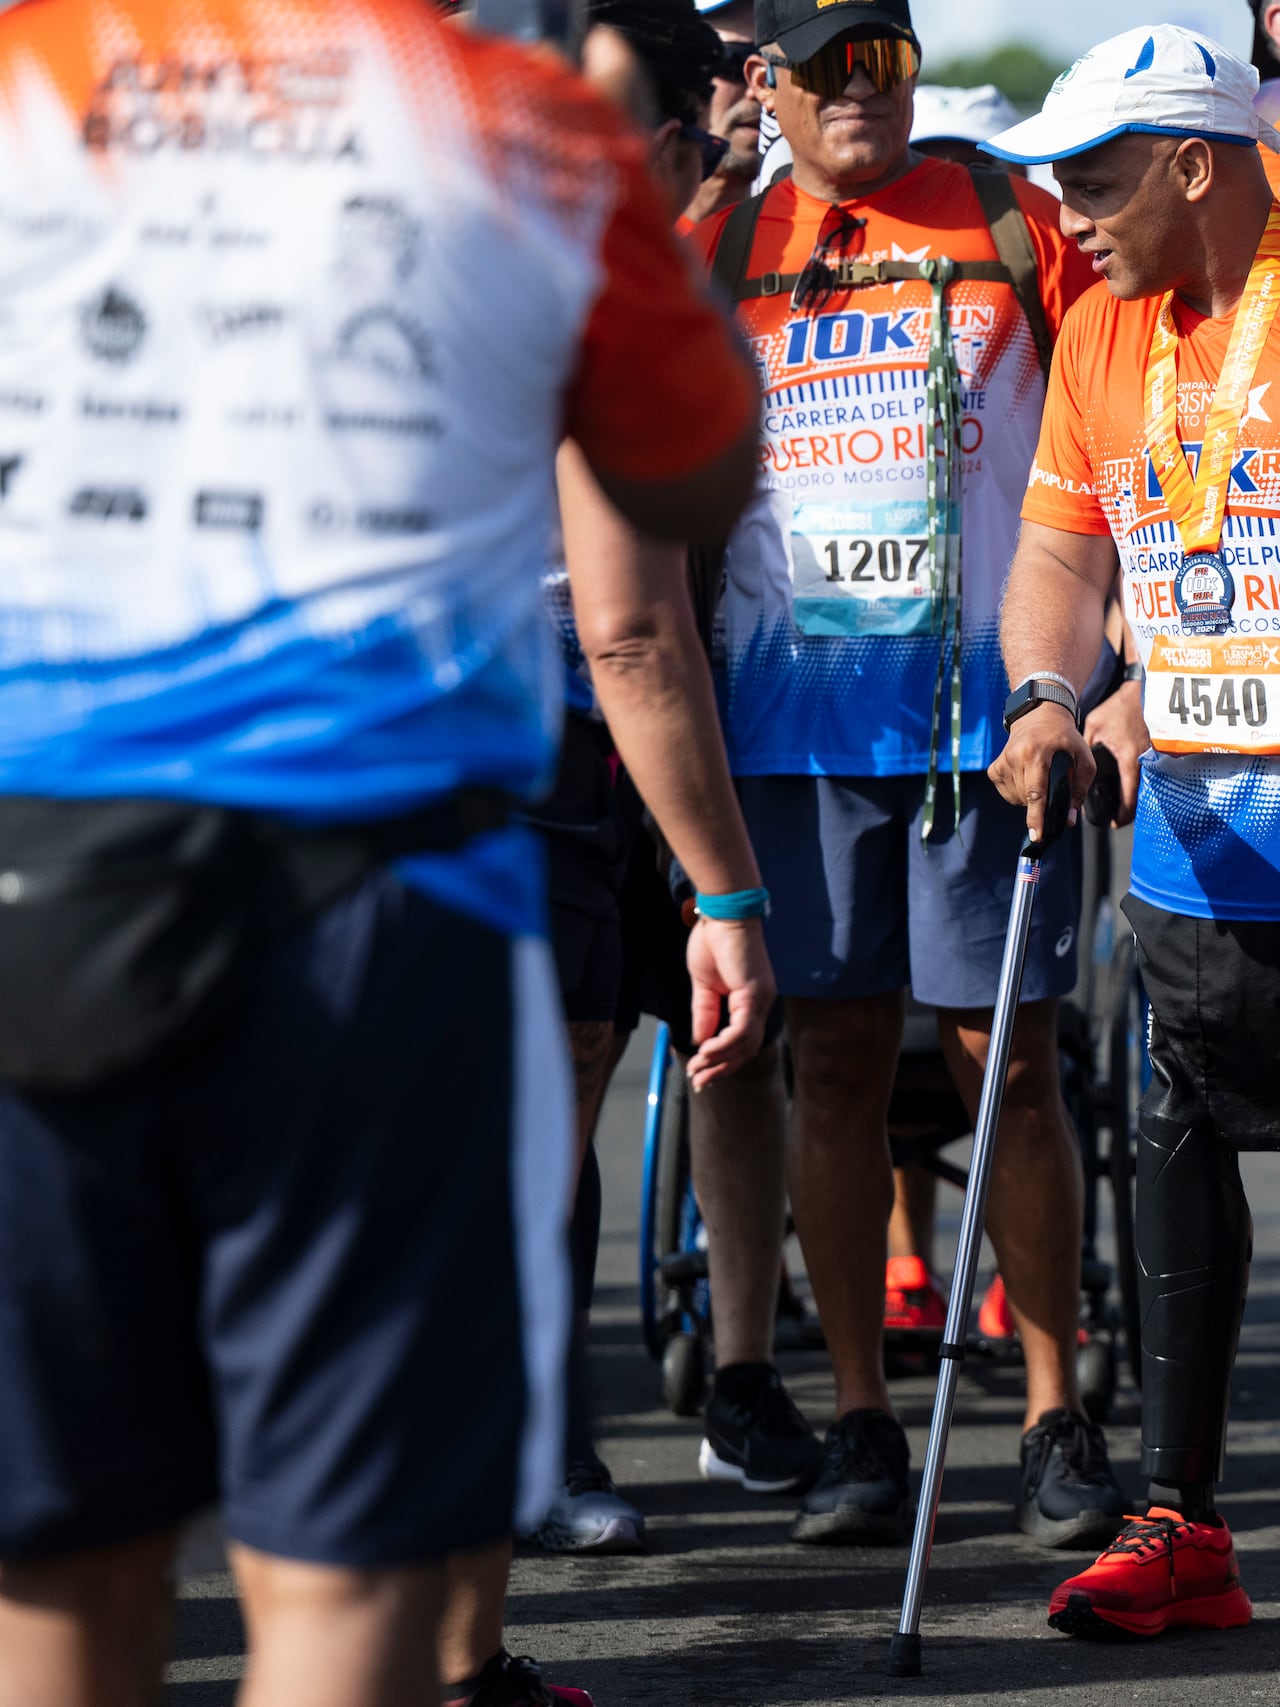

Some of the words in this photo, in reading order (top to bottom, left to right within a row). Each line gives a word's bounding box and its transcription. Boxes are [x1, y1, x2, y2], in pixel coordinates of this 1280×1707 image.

[1259, 271, 1276, 299] RUN
[785, 309, 919, 366] 10K
[765, 402, 865, 433] CARRERA
[870, 398, 910, 420] DEL
[914, 391, 986, 416] PNTE
[1104, 459, 1133, 488] PR
[824, 539, 929, 582] 1207
[1222, 546, 1259, 566] DEL
[1194, 567, 1208, 577] PR
[1186, 576, 1219, 593] 10K
[1193, 591, 1214, 602] RUN
[1181, 611, 1208, 622] PUERTO
[1209, 609, 1229, 619] RICO
[1195, 625, 1216, 634] 2024
[1222, 648, 1262, 661] TURISMO
[1168, 677, 1268, 728] 4540
